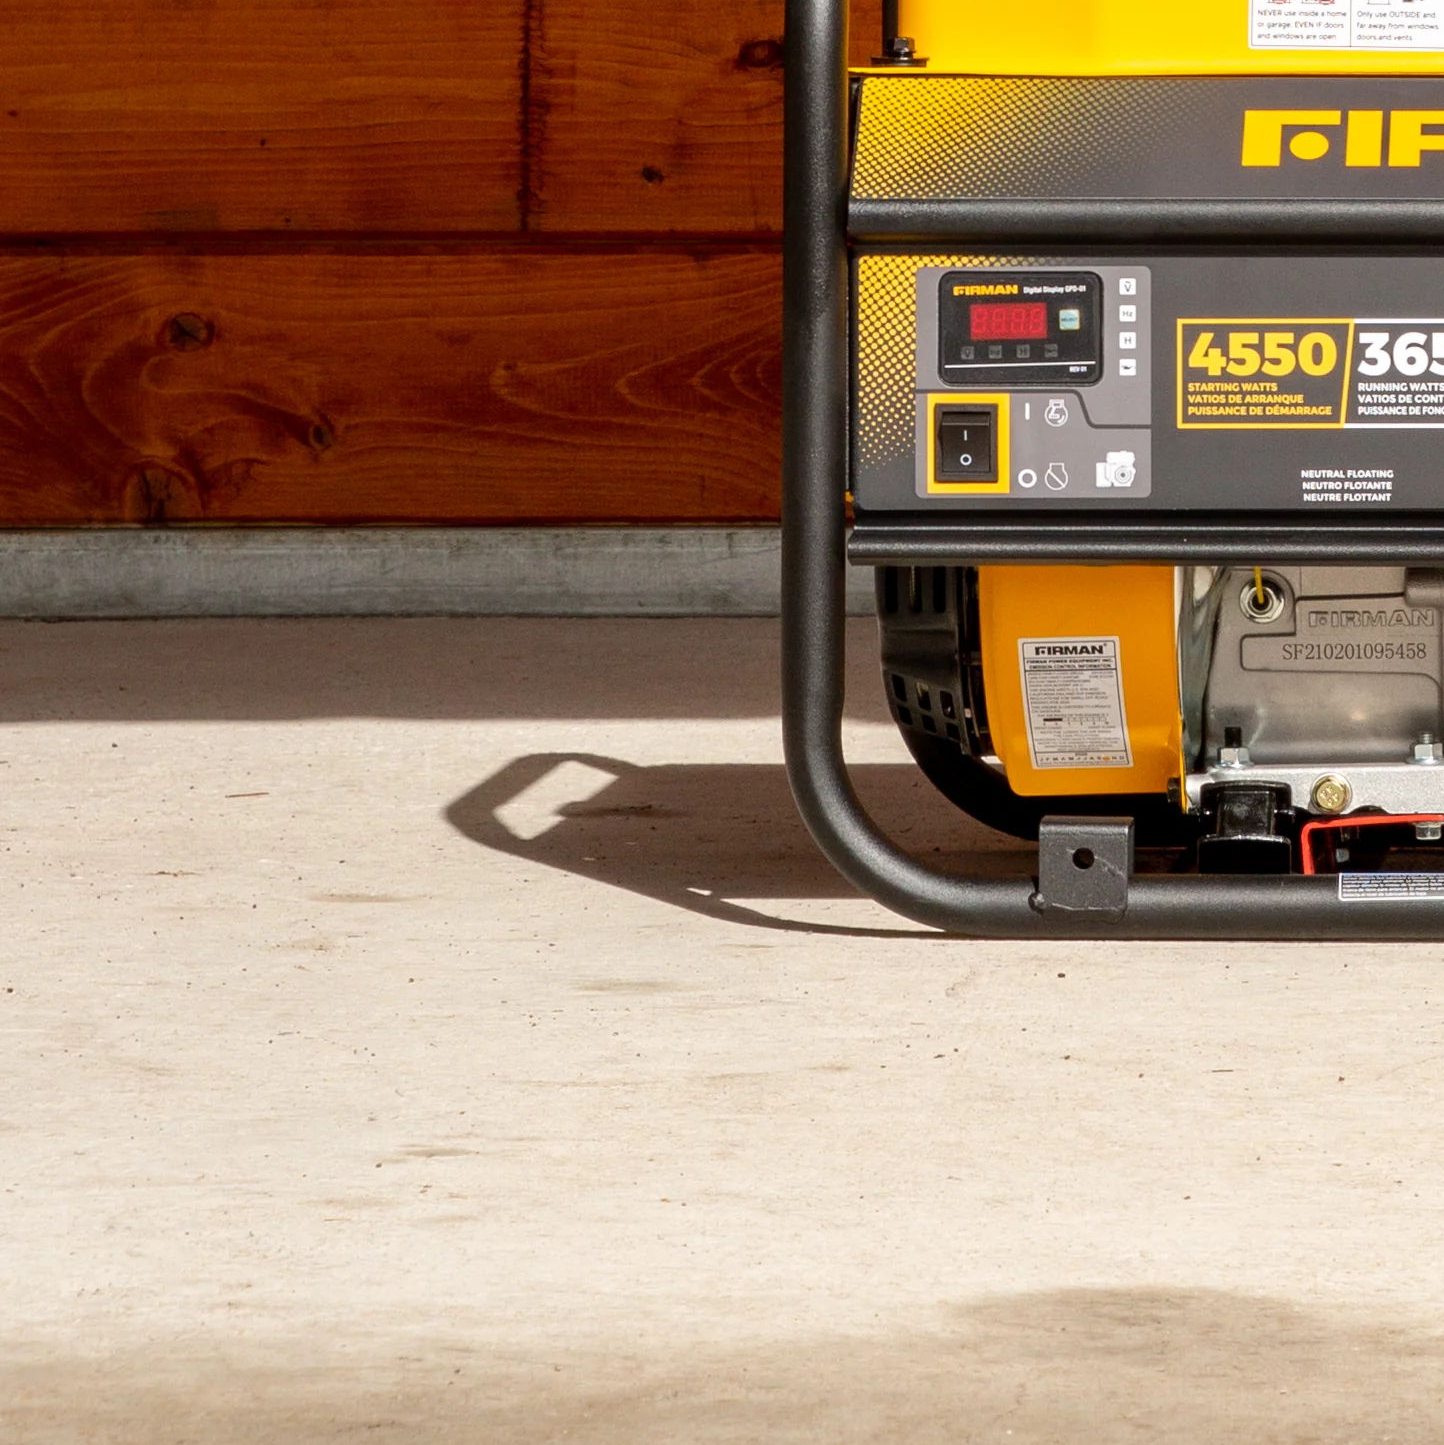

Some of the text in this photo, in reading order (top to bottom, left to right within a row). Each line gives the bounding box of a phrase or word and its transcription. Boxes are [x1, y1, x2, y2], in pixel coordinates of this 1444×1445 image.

[953, 284, 1019, 296] FIRMAN
[1188, 332, 1338, 377] 4550
[1188, 383, 1278, 391] STARTING WATTS
[1358, 383, 1408, 391] RUNNING
[1188, 394, 1304, 405] VATIOS DE ARRANQUE
[1358, 394, 1396, 403] VATIOS
[1398, 394, 1412, 403] DE
[1188, 404, 1332, 415] PUISSANCE DE DÉMARRAGE
[1358, 406, 1407, 415] PUISSANCE
[1409, 406, 1421, 415] DE
[1301, 470, 1394, 478] NEUTRAL FLOATING
[1344, 482, 1392, 490] FLOTANTE
[1304, 493, 1392, 501] NEUTRE FLOTTANT
[1308, 609, 1435, 628] FIRMAN
[1282, 642, 1427, 660] SF210201095458
